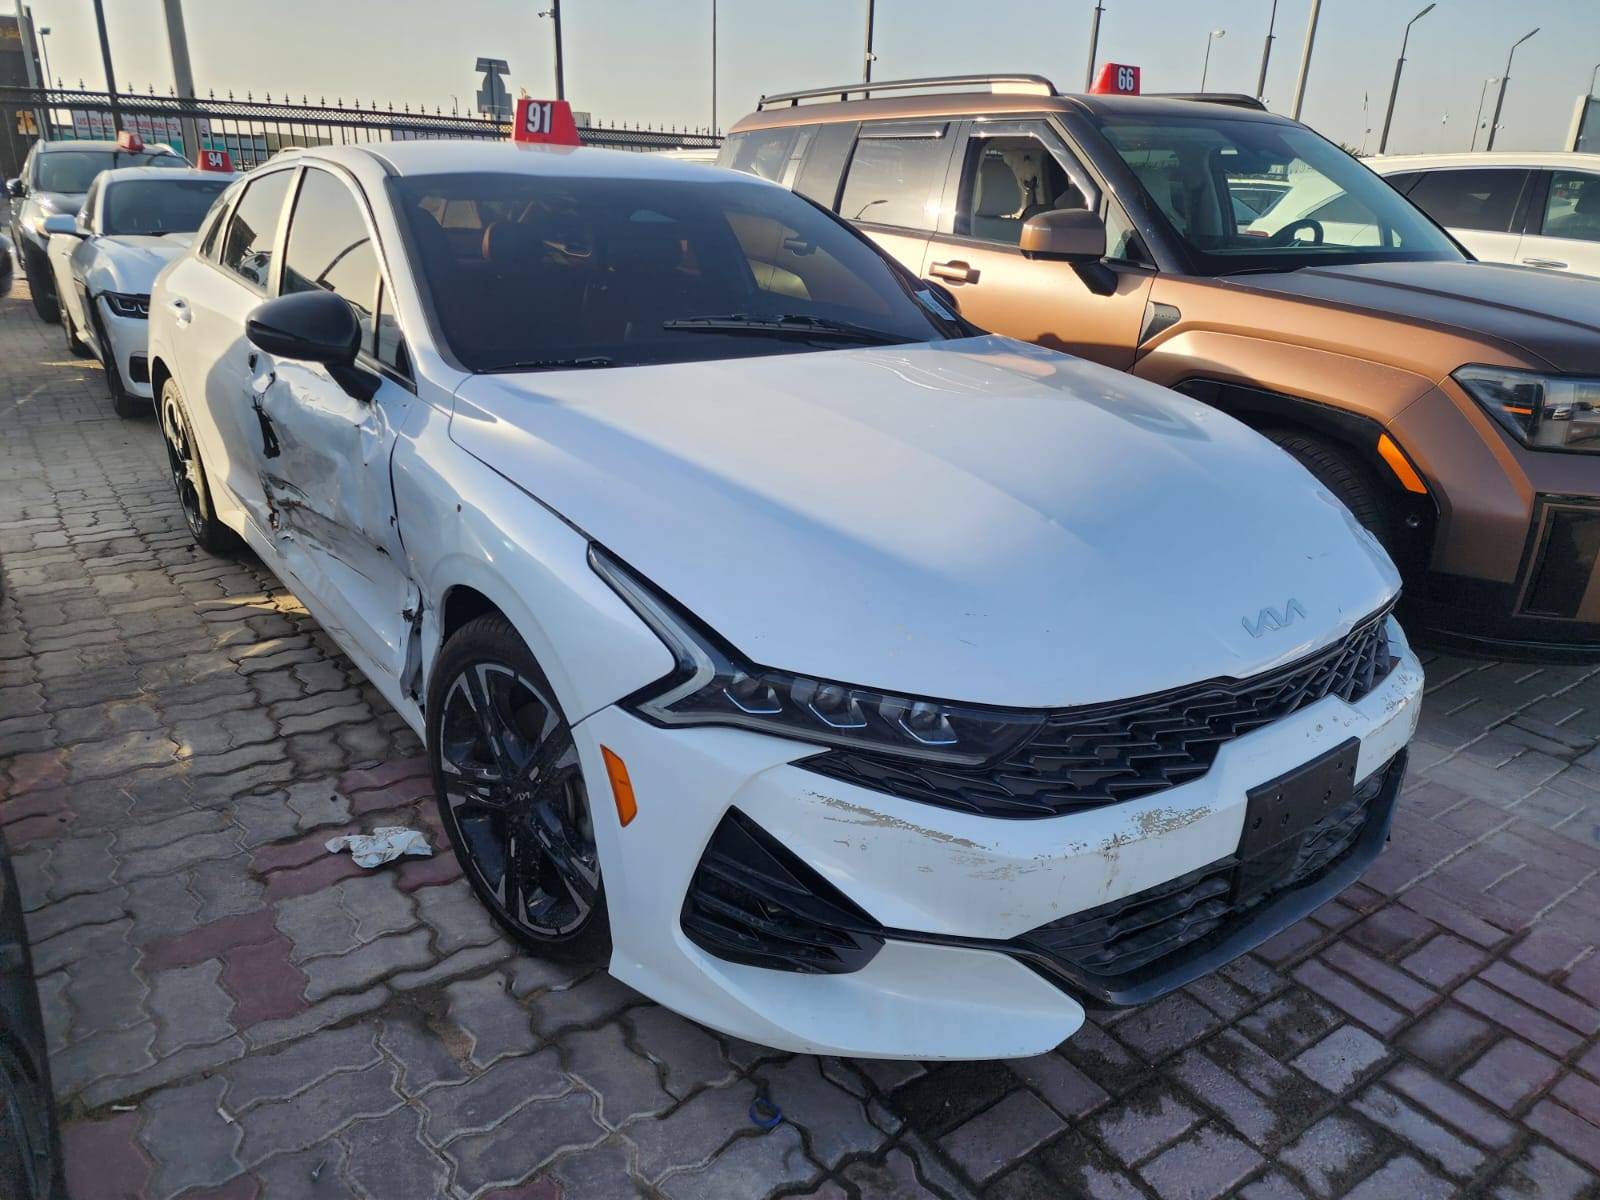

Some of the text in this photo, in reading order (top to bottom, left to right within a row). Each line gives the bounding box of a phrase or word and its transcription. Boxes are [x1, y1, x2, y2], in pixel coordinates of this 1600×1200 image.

[1118, 67, 1134, 91] 66
[527, 102, 552, 133] 91
[208, 152, 223, 167] 94
[1241, 598, 1305, 638] KIA
